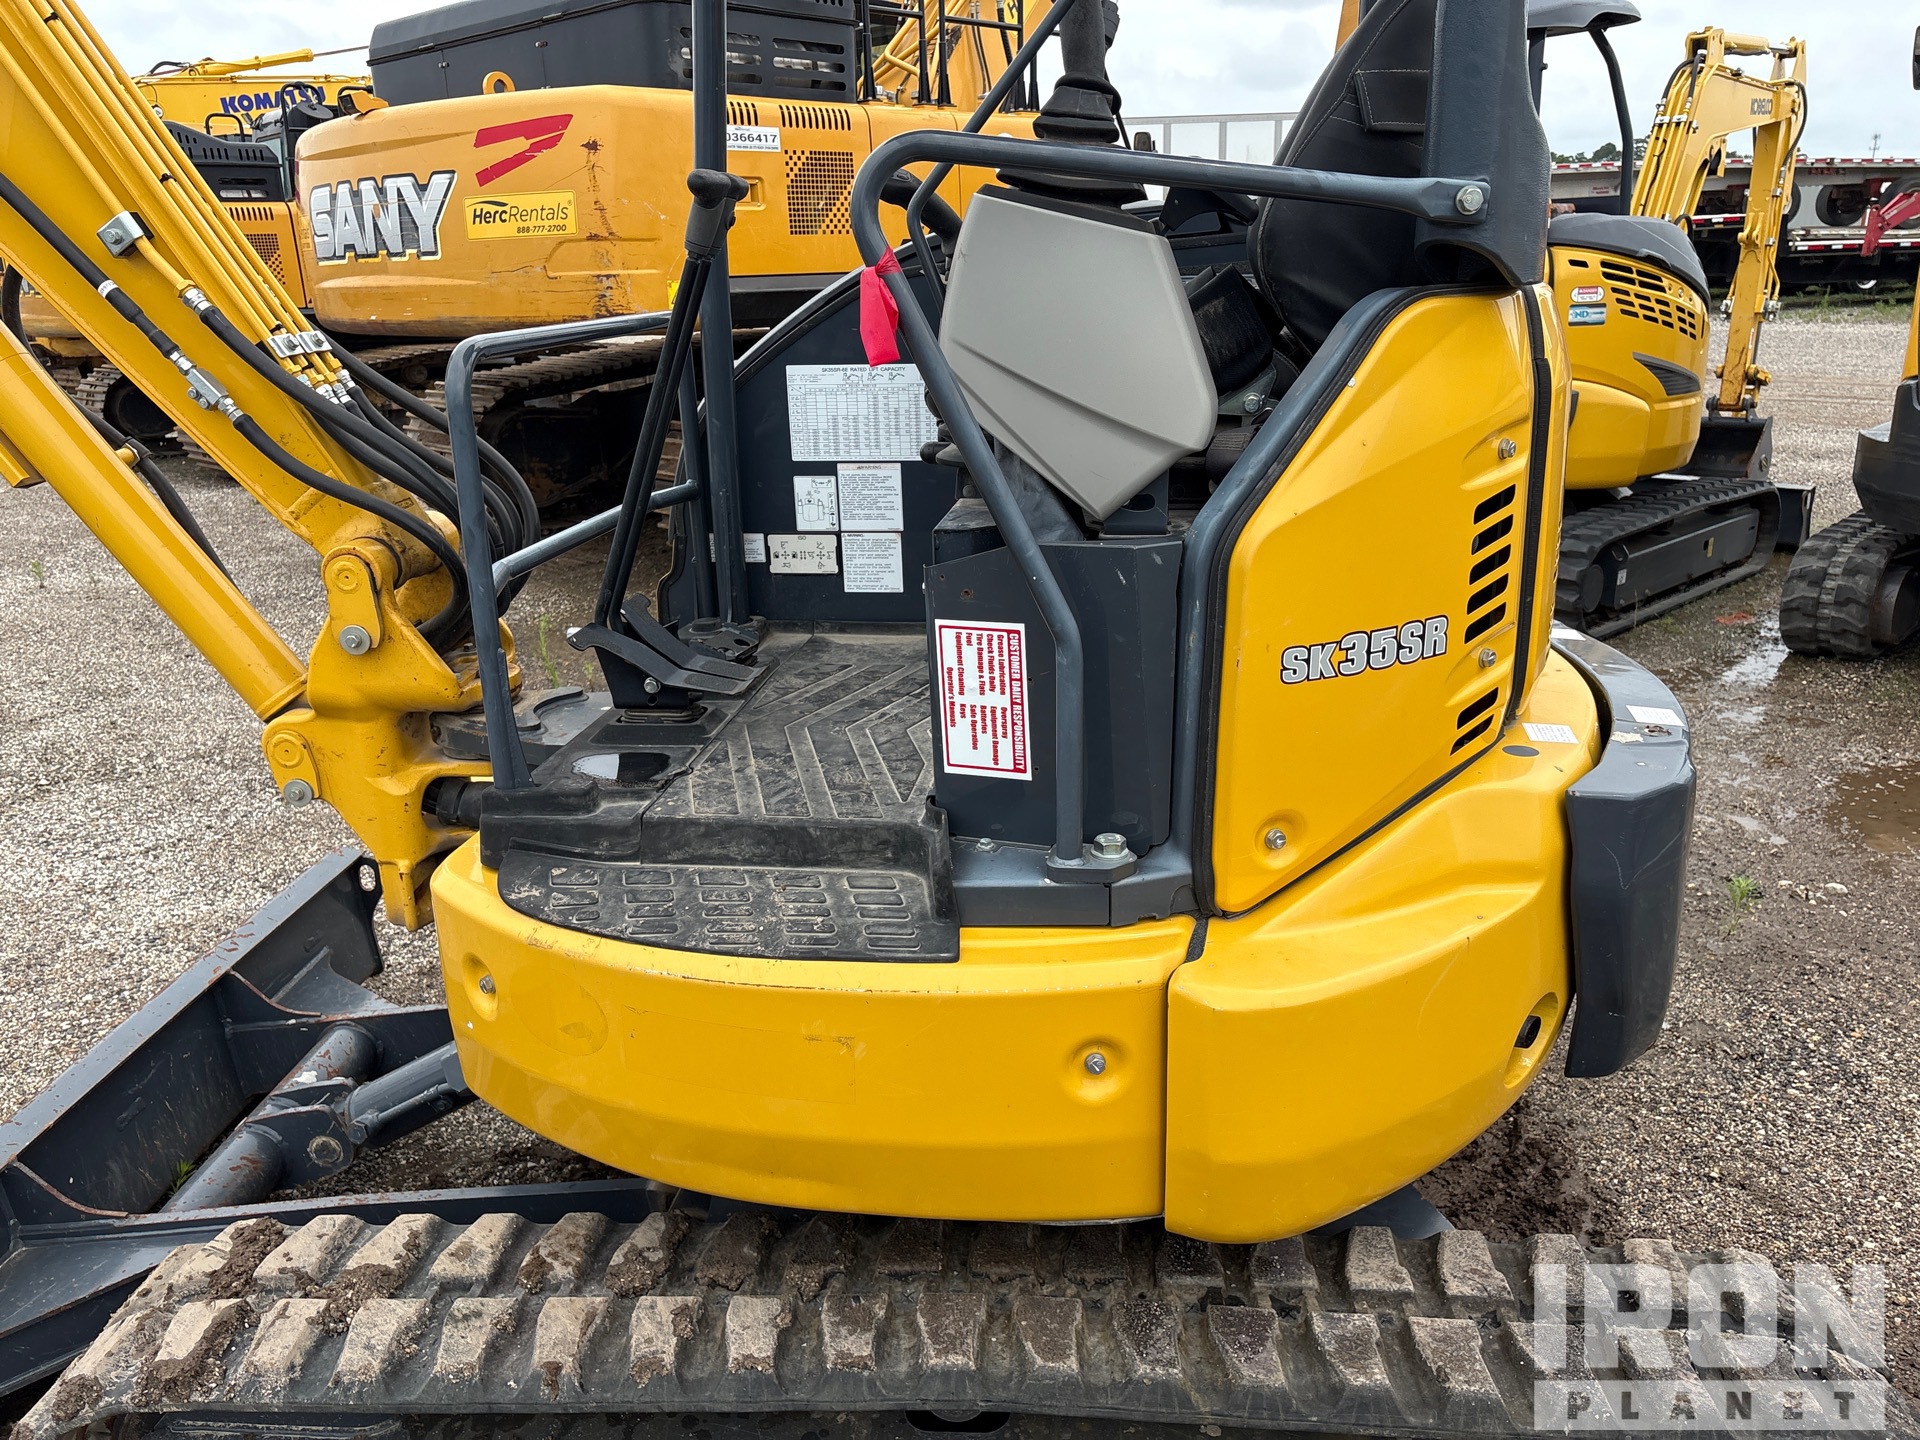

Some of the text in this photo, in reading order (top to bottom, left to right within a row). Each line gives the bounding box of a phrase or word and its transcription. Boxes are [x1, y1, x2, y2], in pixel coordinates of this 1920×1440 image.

[311, 170, 457, 264] SANY
[516, 224, 567, 234] 888-777-2700
[955, 632, 964, 666] Equipment
[1280, 615, 1449, 685] SK35SR
[947, 667, 955, 699] Operator's
[1010, 634, 1024, 770] CUSTOMER DAILY RESPONSIBILITY
